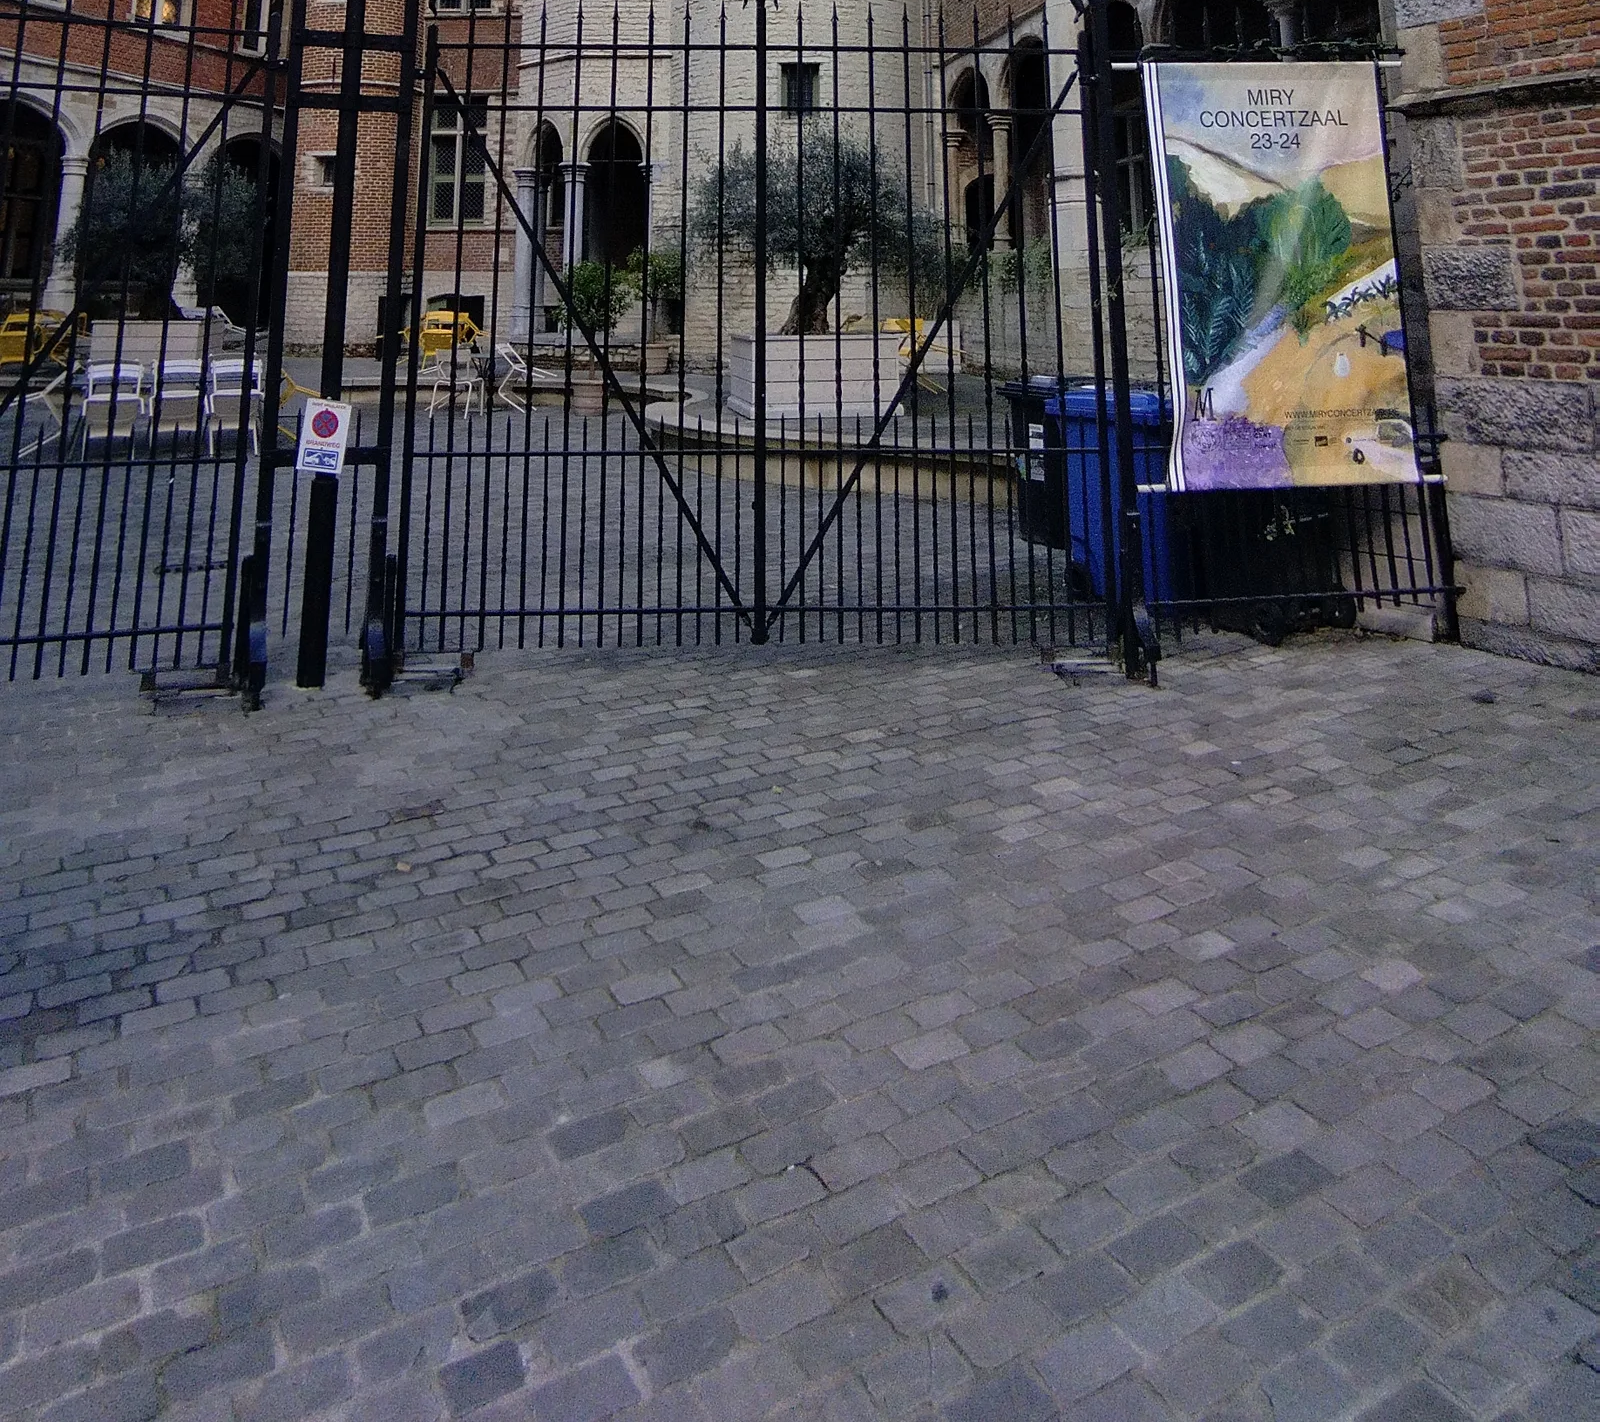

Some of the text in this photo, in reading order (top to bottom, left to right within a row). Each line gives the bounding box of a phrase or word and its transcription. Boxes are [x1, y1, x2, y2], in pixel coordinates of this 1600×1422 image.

[1247, 89, 1294, 106] MIRY
[1199, 109, 1349, 128] CONCERTZAAL
[1250, 132, 1301, 149] 23-24
[1191, 387, 1217, 422] M
